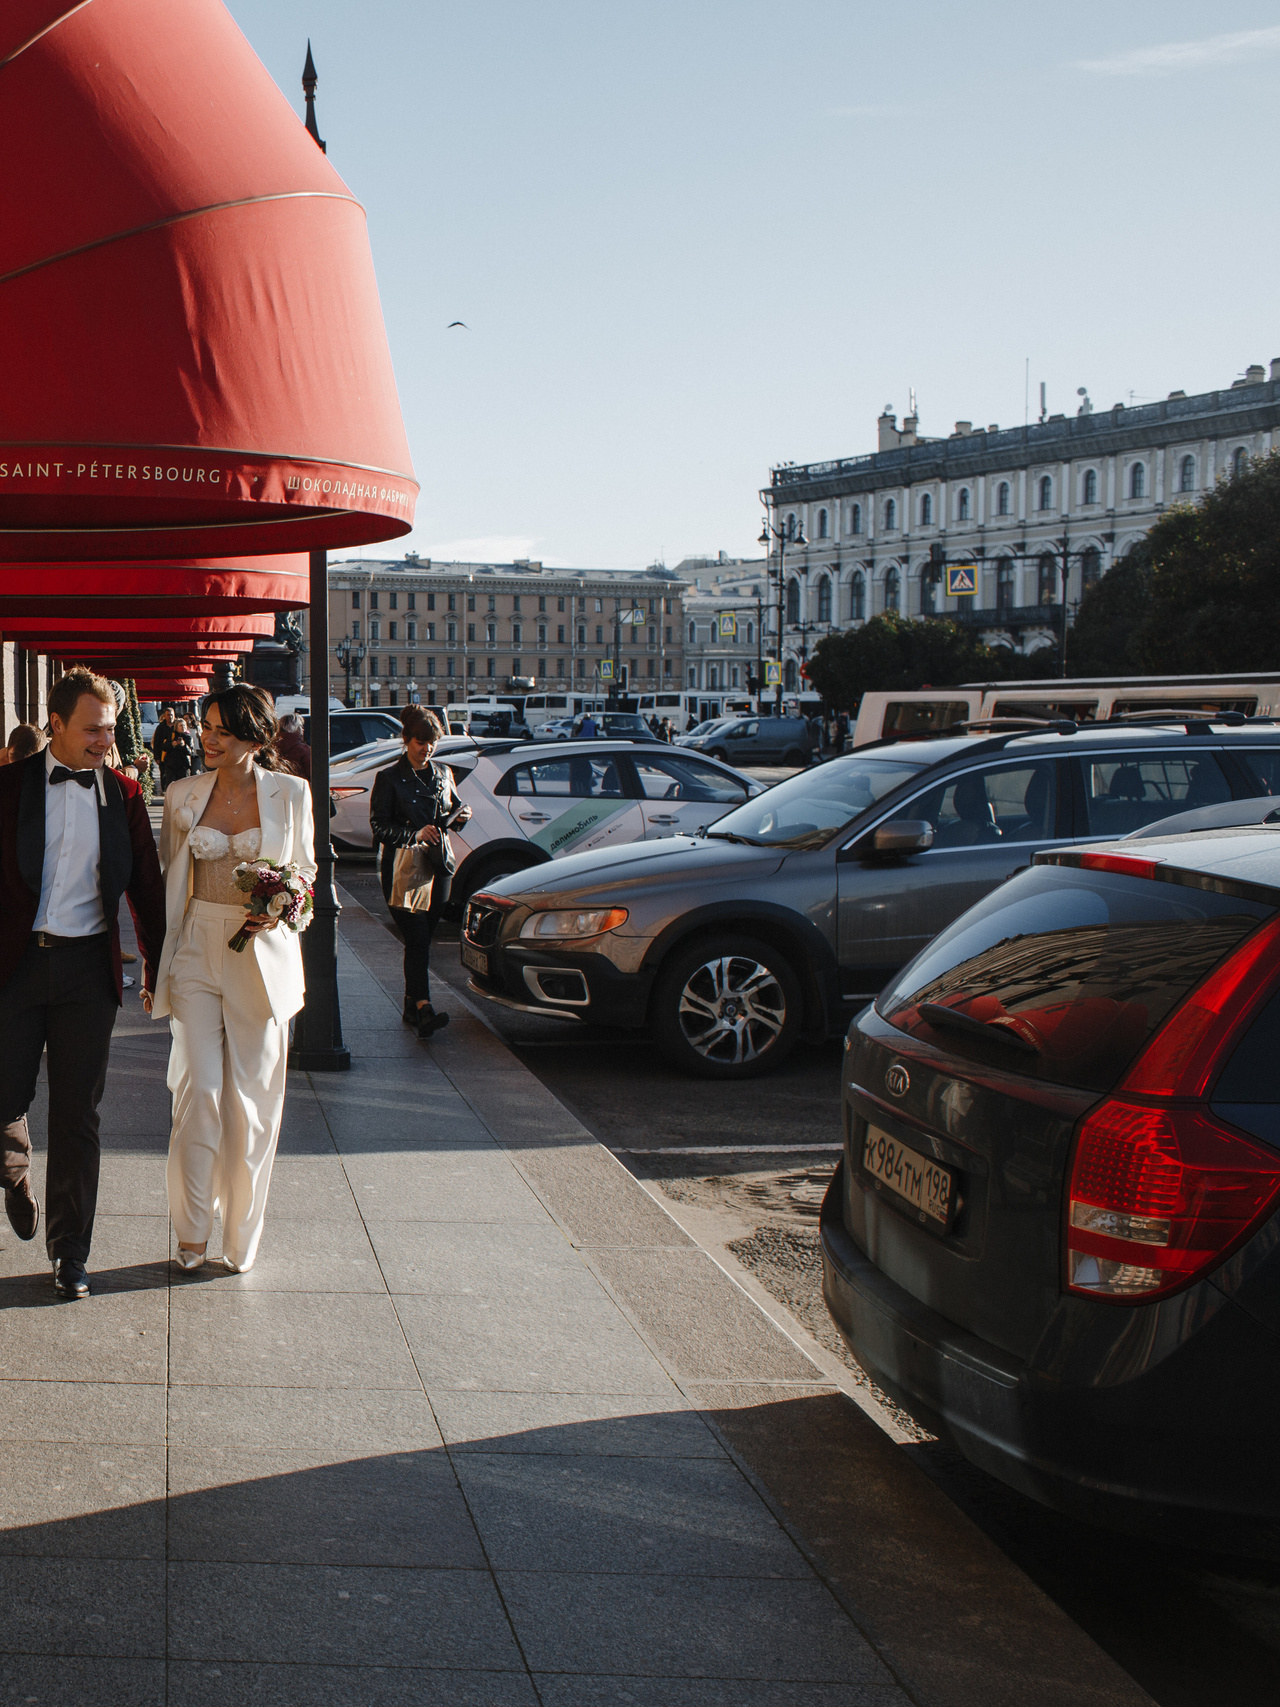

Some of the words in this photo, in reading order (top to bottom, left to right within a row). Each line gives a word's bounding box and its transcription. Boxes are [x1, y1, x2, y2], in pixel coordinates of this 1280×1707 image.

[0, 461, 220, 483] SAINT-PÉTERSBOURG
[287, 476, 378, 499] ШОКОЛАДНАЯ
[550, 815, 598, 851] делимобиль
[887, 1069, 906, 1093] KIA
[926, 1166, 948, 1206] 198
